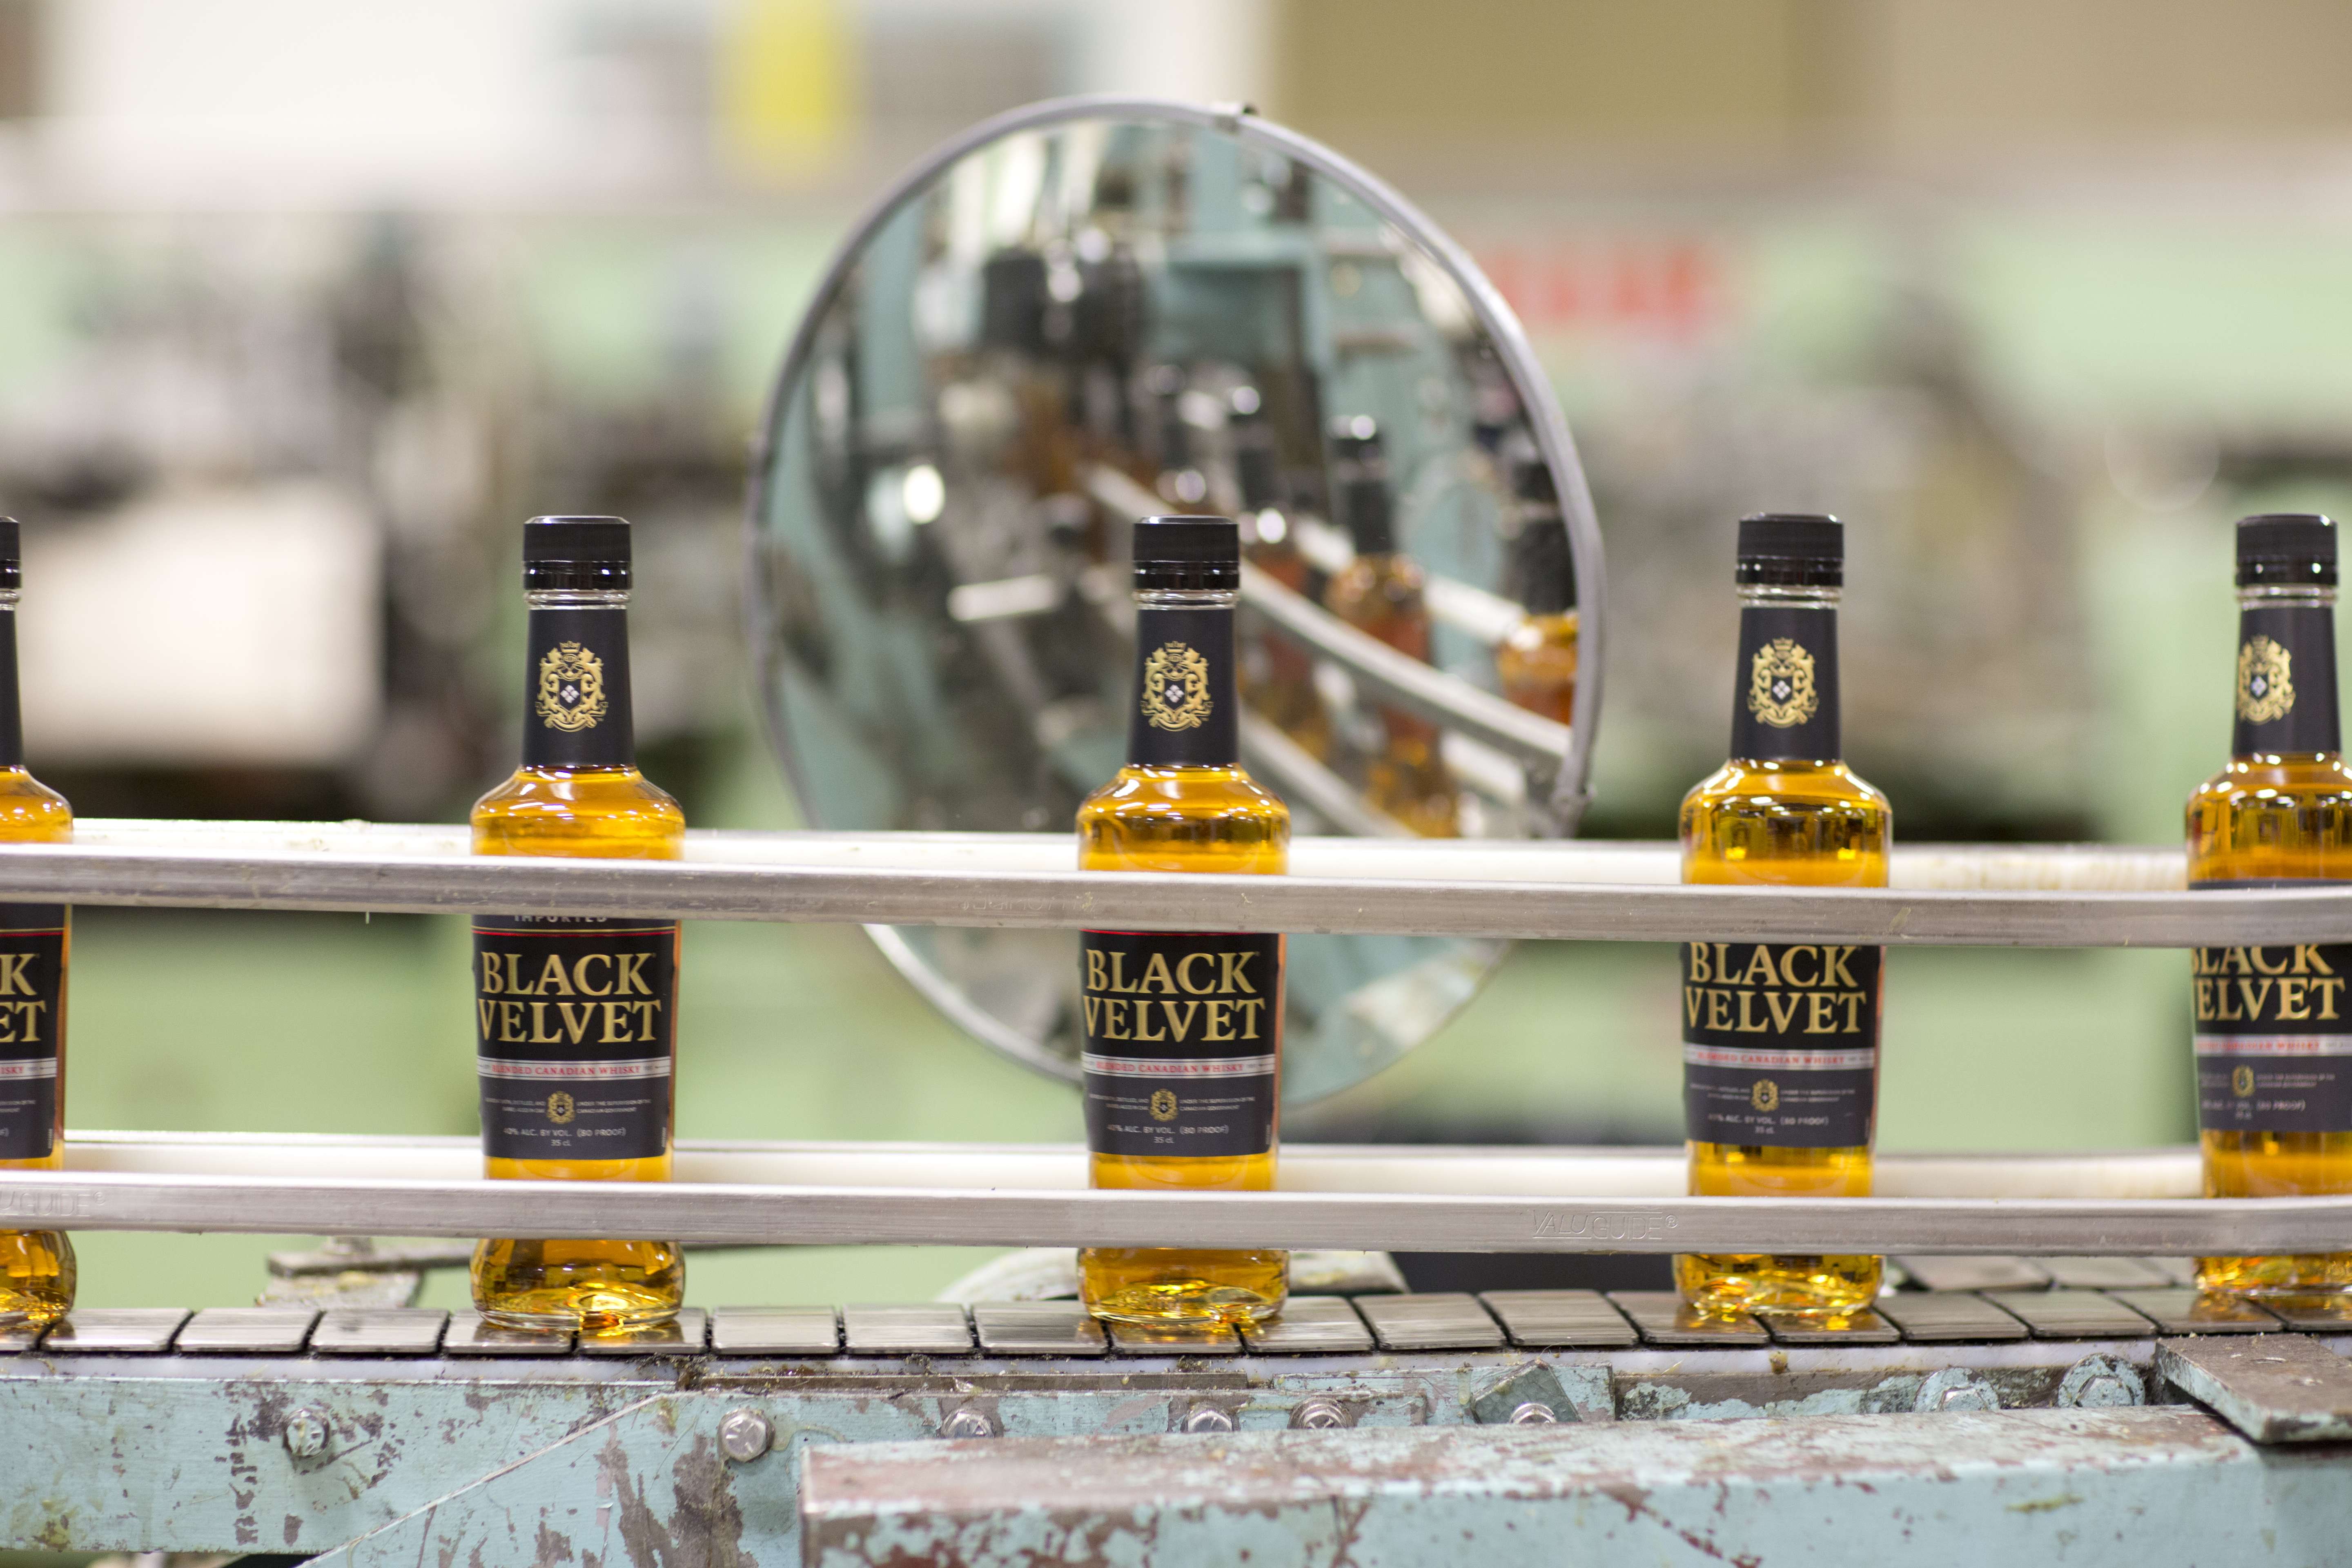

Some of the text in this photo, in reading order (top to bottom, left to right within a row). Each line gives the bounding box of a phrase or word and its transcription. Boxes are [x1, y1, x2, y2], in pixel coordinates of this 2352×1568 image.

[481, 952, 653, 996] BLACK
[1086, 949, 1257, 995] BLACK
[1690, 942, 1859, 988] BLACK
[478, 999, 662, 1045] VELVET
[1083, 996, 1265, 1042] VELVET
[1685, 986, 1866, 1034] VELVET
[2194, 977, 2345, 1021] ELVET
[535, 1067, 595, 1075] CANADIAN
[599, 1066, 640, 1074] WHISKY
[1138, 1065, 1198, 1073] CANADIAN
[1202, 1064, 1243, 1072] WHISKY
